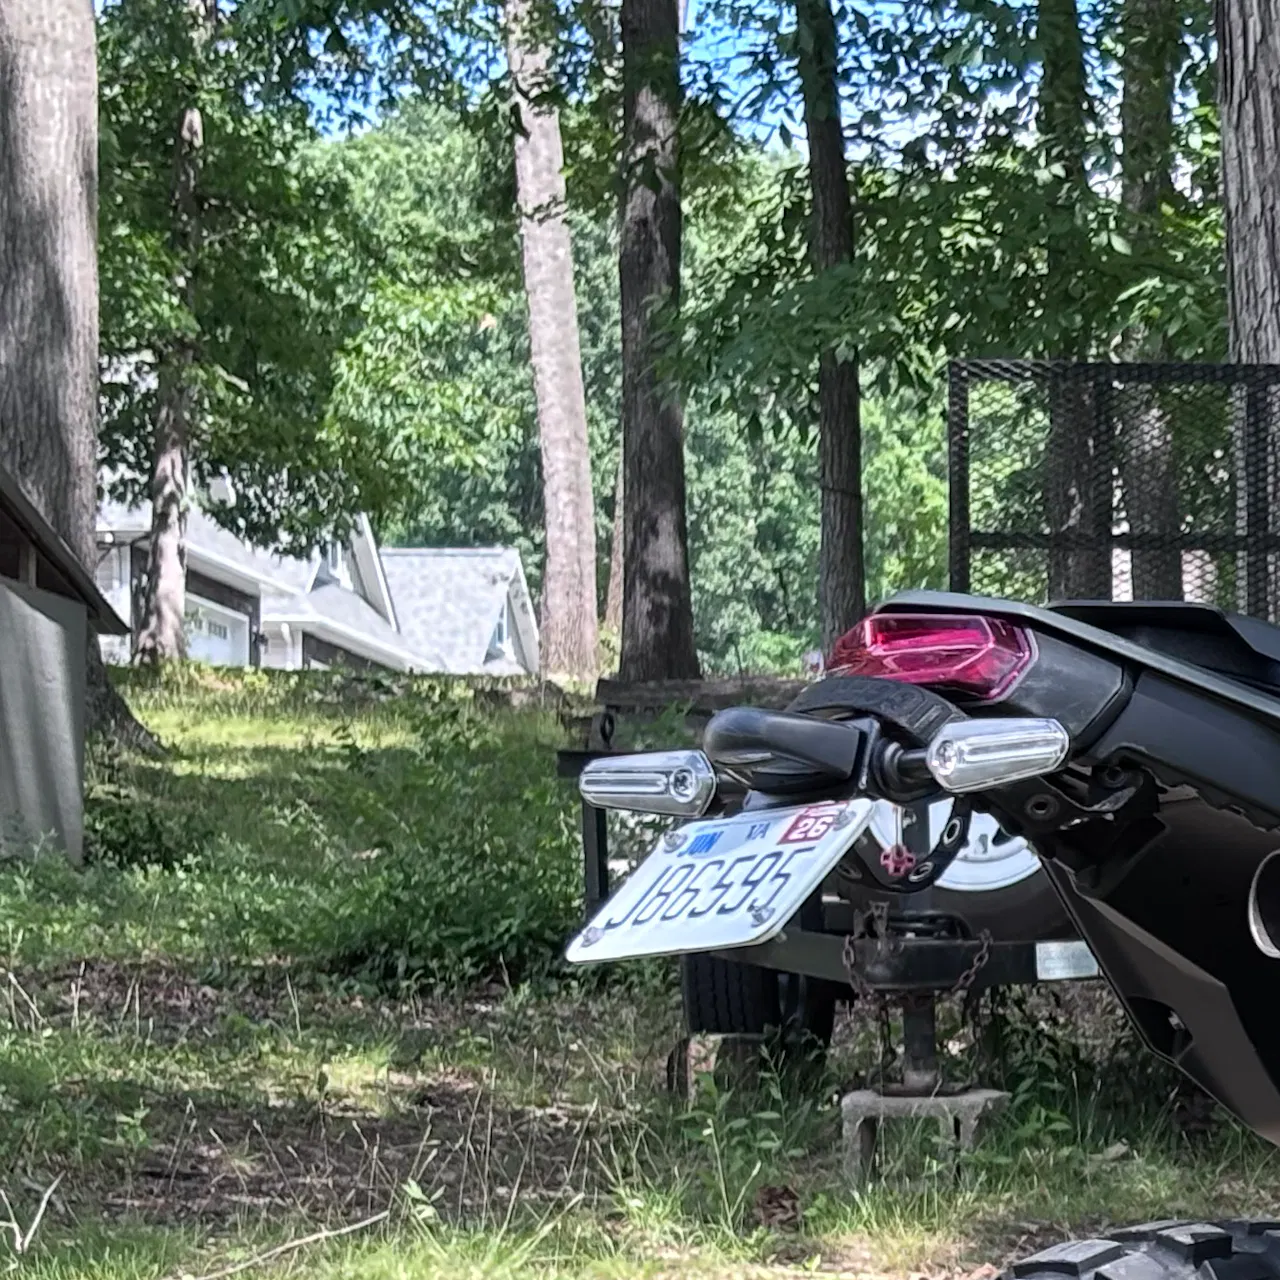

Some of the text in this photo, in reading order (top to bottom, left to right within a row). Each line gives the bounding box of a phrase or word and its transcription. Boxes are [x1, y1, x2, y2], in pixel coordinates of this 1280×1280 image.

[744, 822, 772, 842] VA
[787, 816, 835, 841] 26
[604, 846, 816, 930] J86595
